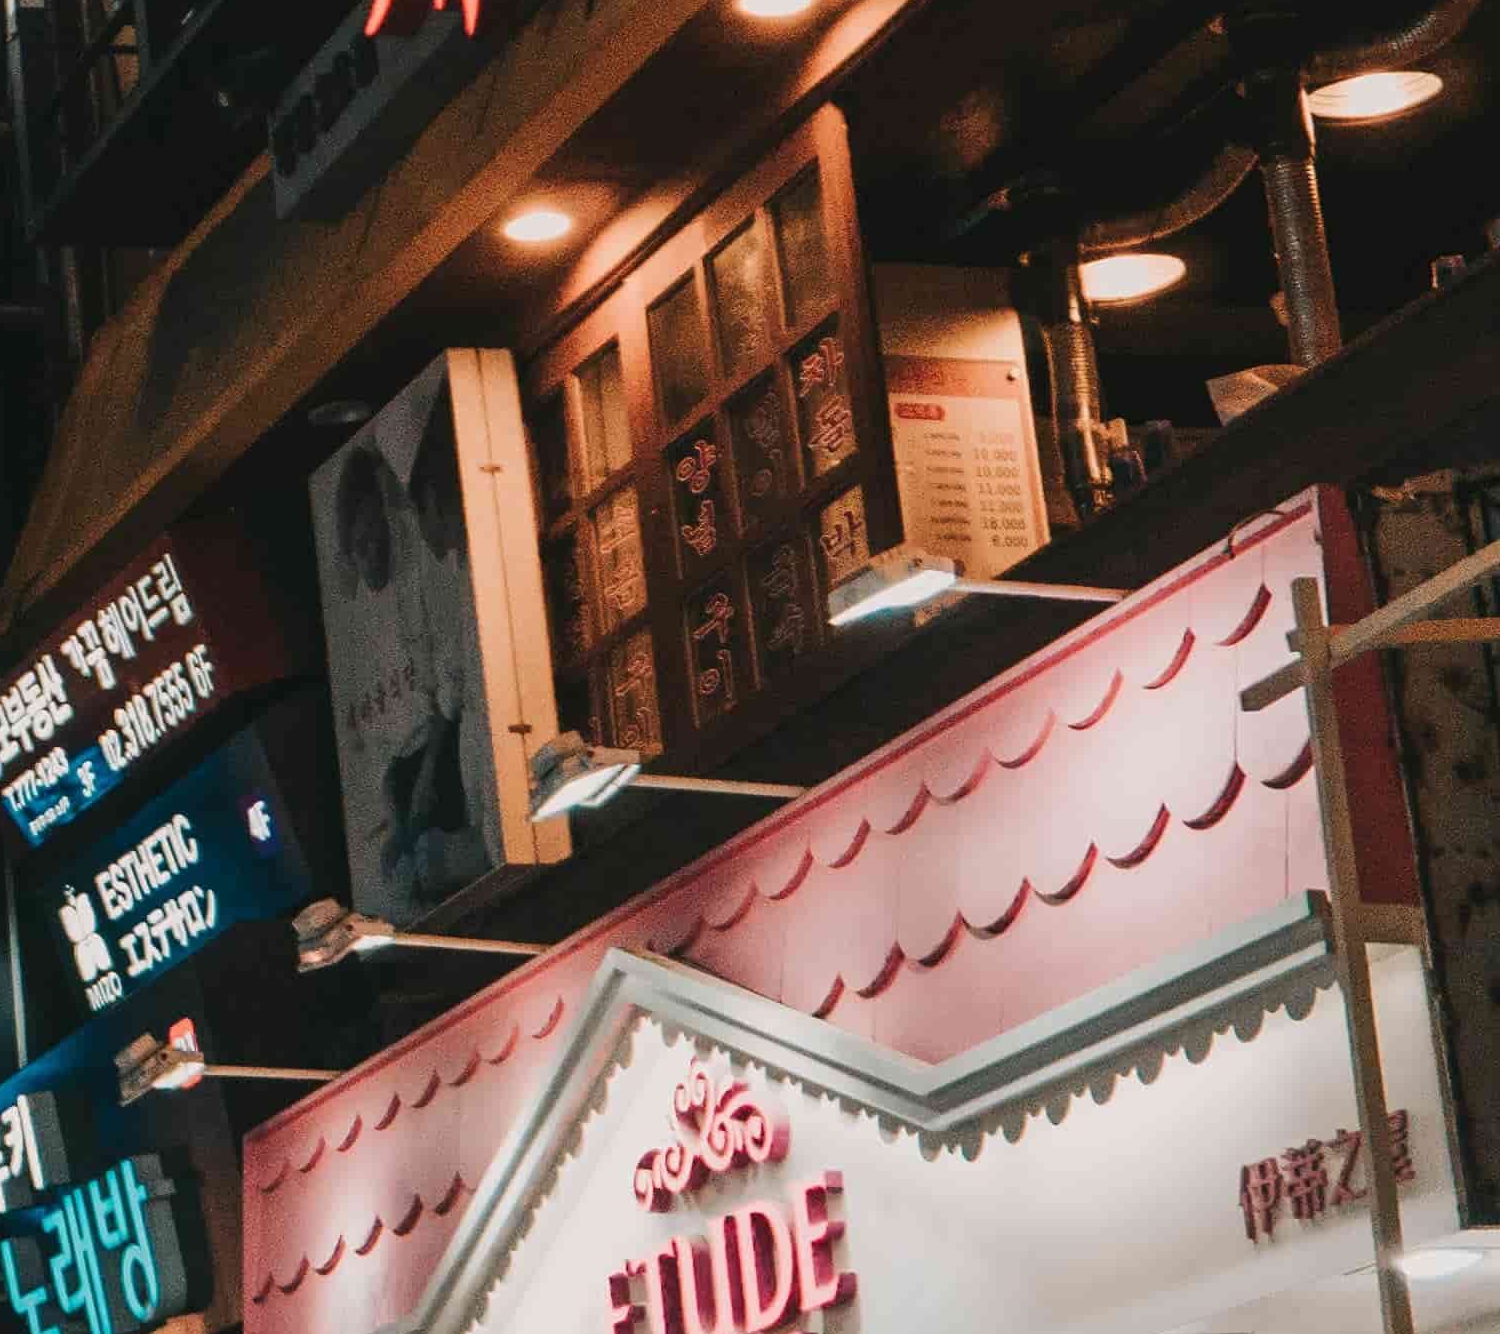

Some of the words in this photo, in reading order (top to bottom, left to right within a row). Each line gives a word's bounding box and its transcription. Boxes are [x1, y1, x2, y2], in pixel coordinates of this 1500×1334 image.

[94, 813, 200, 921] ESTHETIC
[118, 887, 216, 979] エステサロン
[85, 970, 123, 1012] MIZO
